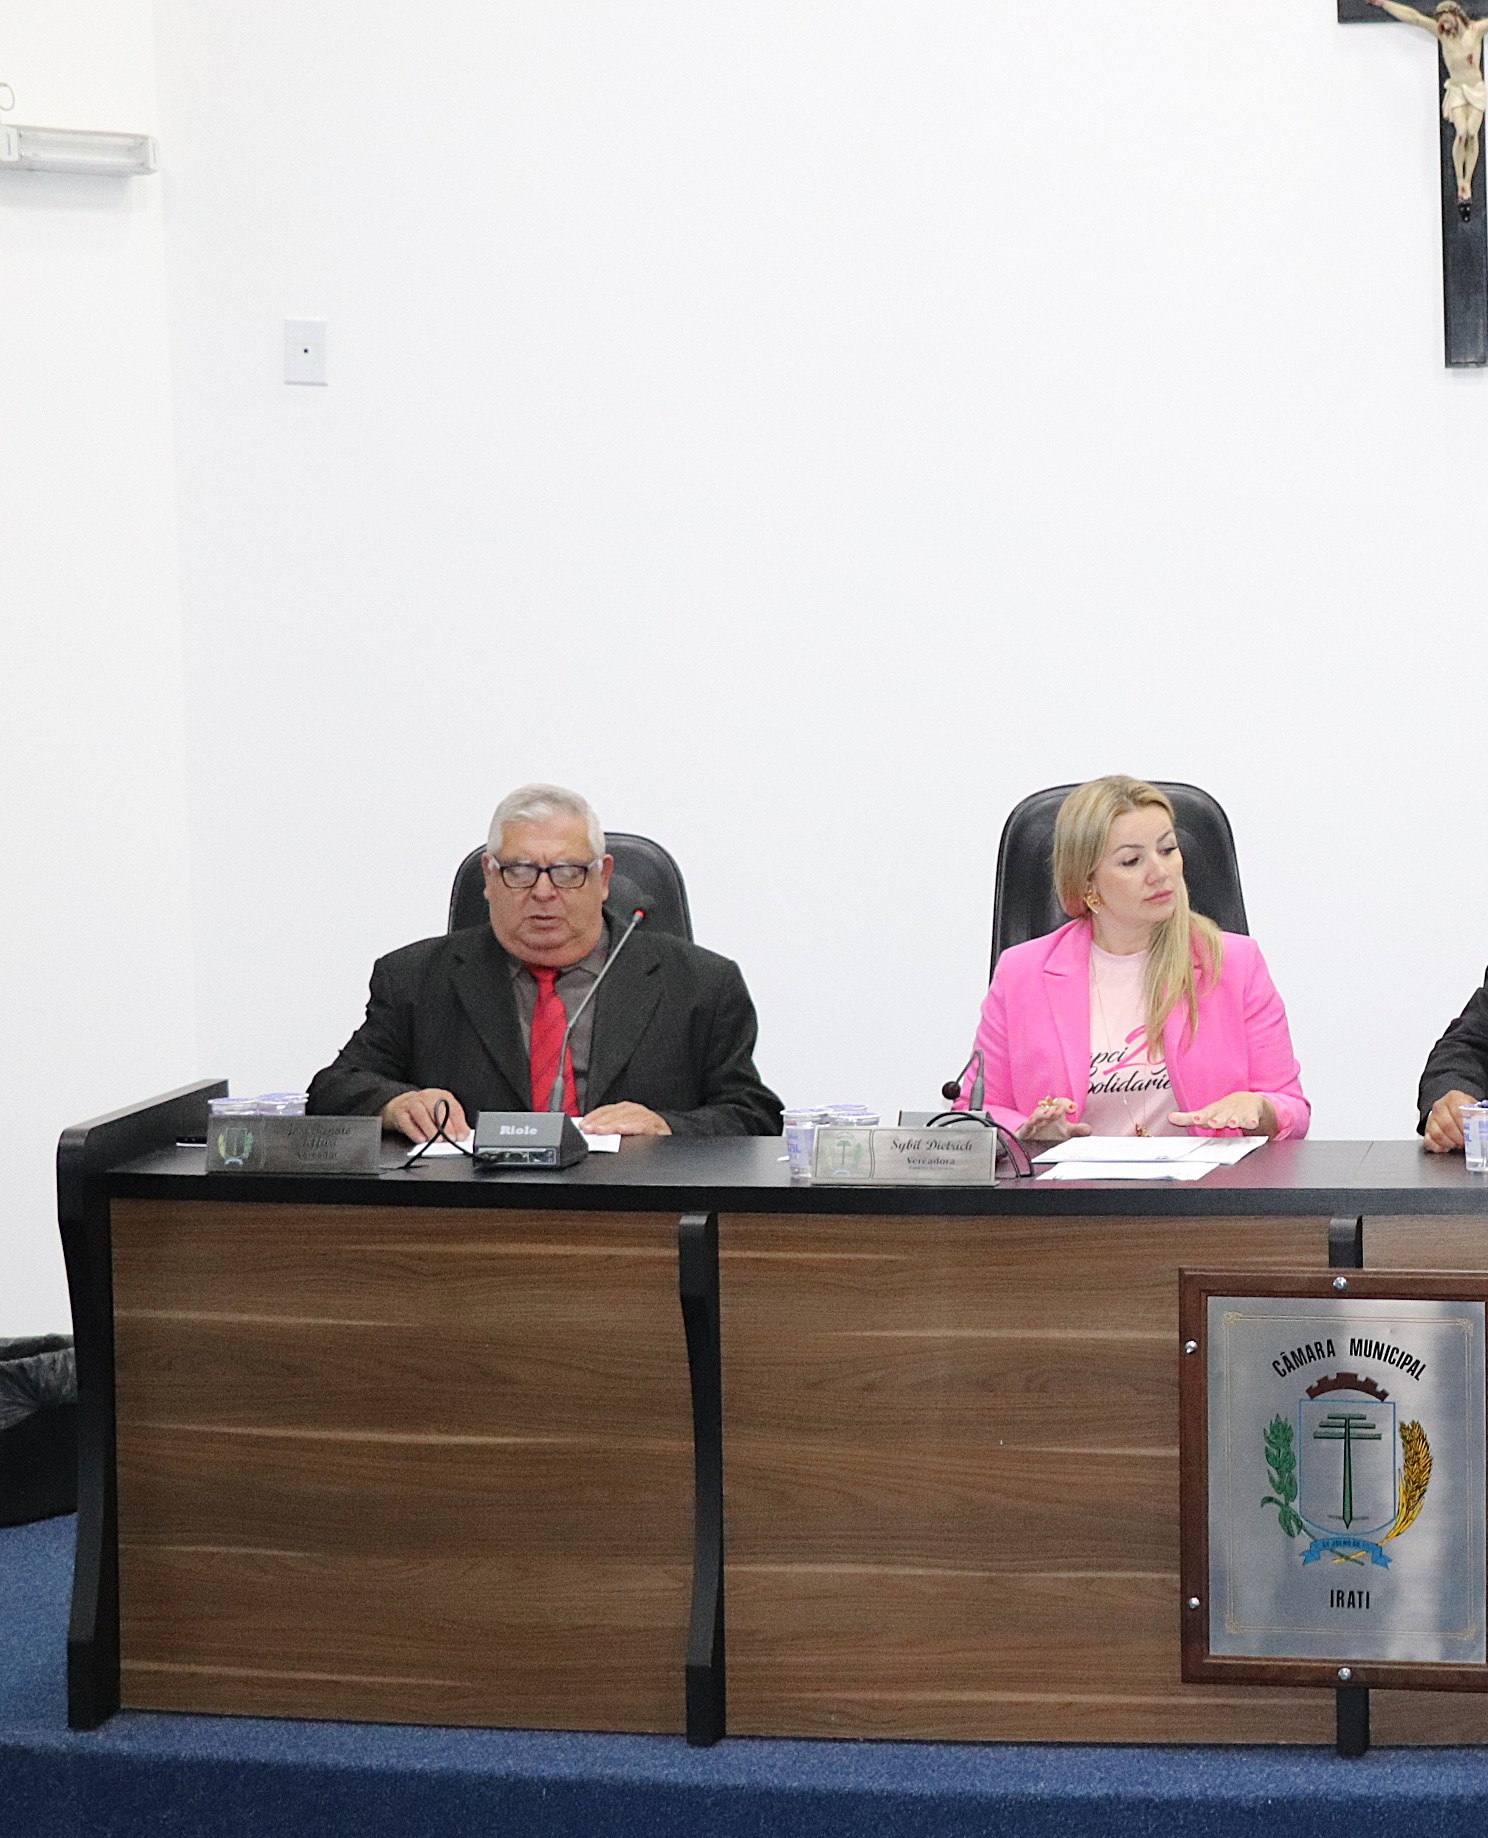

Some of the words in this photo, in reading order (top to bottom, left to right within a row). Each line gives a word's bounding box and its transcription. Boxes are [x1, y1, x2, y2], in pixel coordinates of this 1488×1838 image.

[1090, 1046, 1128, 1069] pci
[500, 1125, 538, 1136] Riole
[891, 1139, 921, 1153] Sybil
[926, 1139, 973, 1151] Dietrich
[907, 1156, 956, 1165] Vereadora
[1272, 1338, 1336, 1378] CÂMARA
[1349, 1338, 1426, 1381] MUNICIPAL
[1330, 1589, 1370, 1610] IRATI
